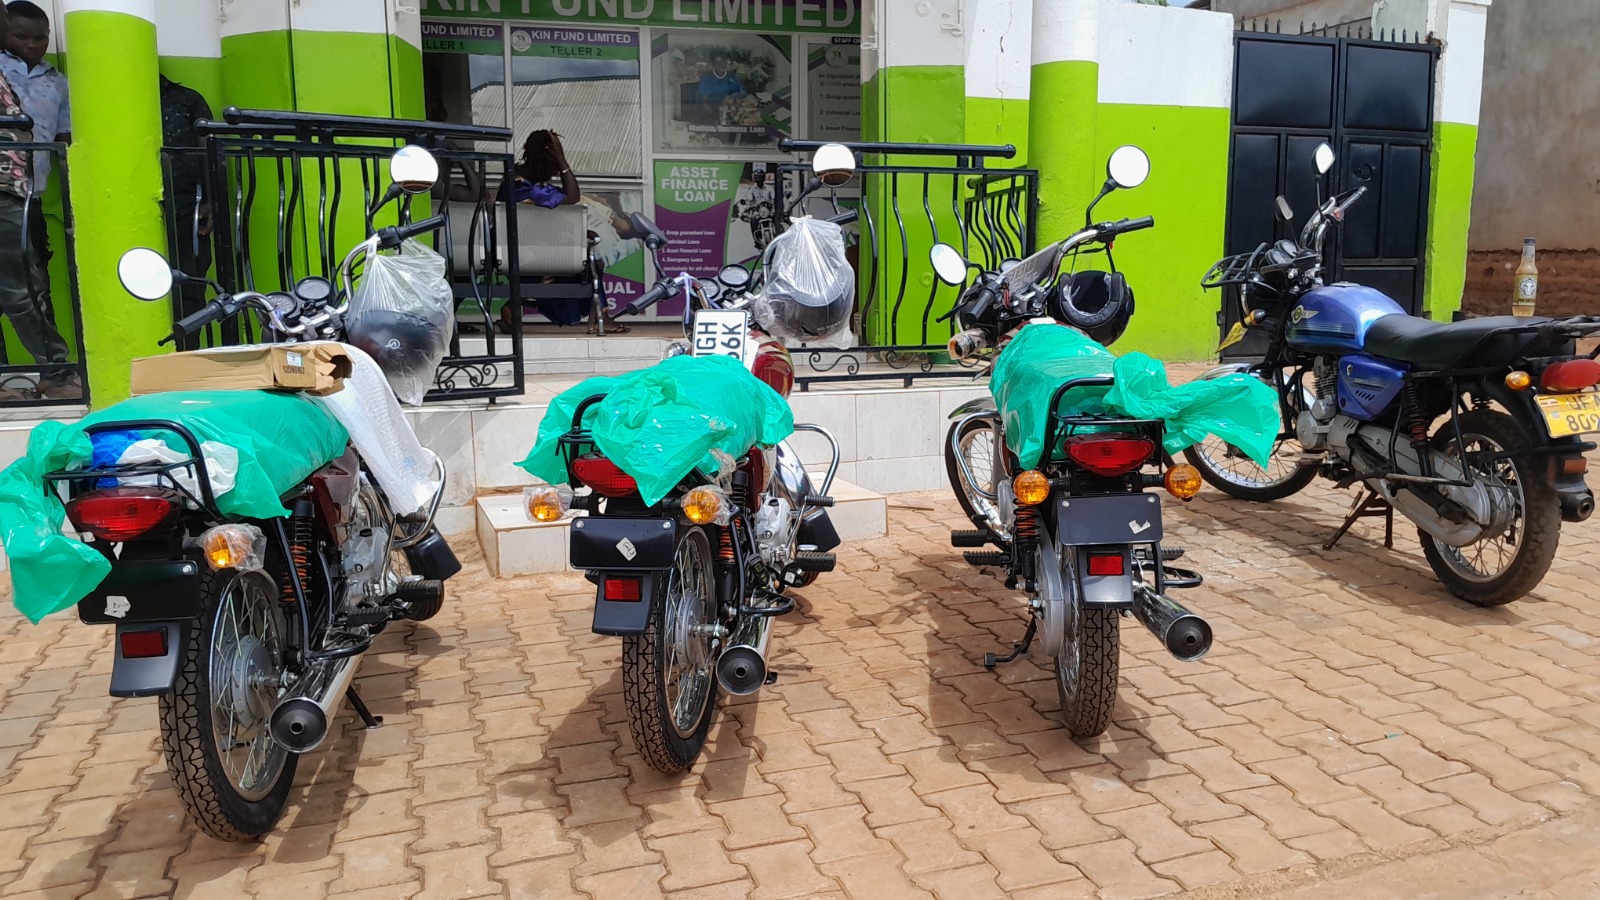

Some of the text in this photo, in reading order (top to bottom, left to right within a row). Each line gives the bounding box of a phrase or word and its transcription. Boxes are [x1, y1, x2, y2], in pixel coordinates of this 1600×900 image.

[672, 0, 855, 28] LIMITED
[422, 25, 495, 38] UND LIMITED
[532, 30, 631, 44] KIN FUND LIMITED
[422, 39, 464, 50] ELLER 1
[551, 45, 602, 57] TELLER 2
[670, 166, 719, 178] ASSET
[661, 178, 729, 190] FINANCE
[675, 190, 716, 202] LOAN
[603, 281, 636, 294] UAL
